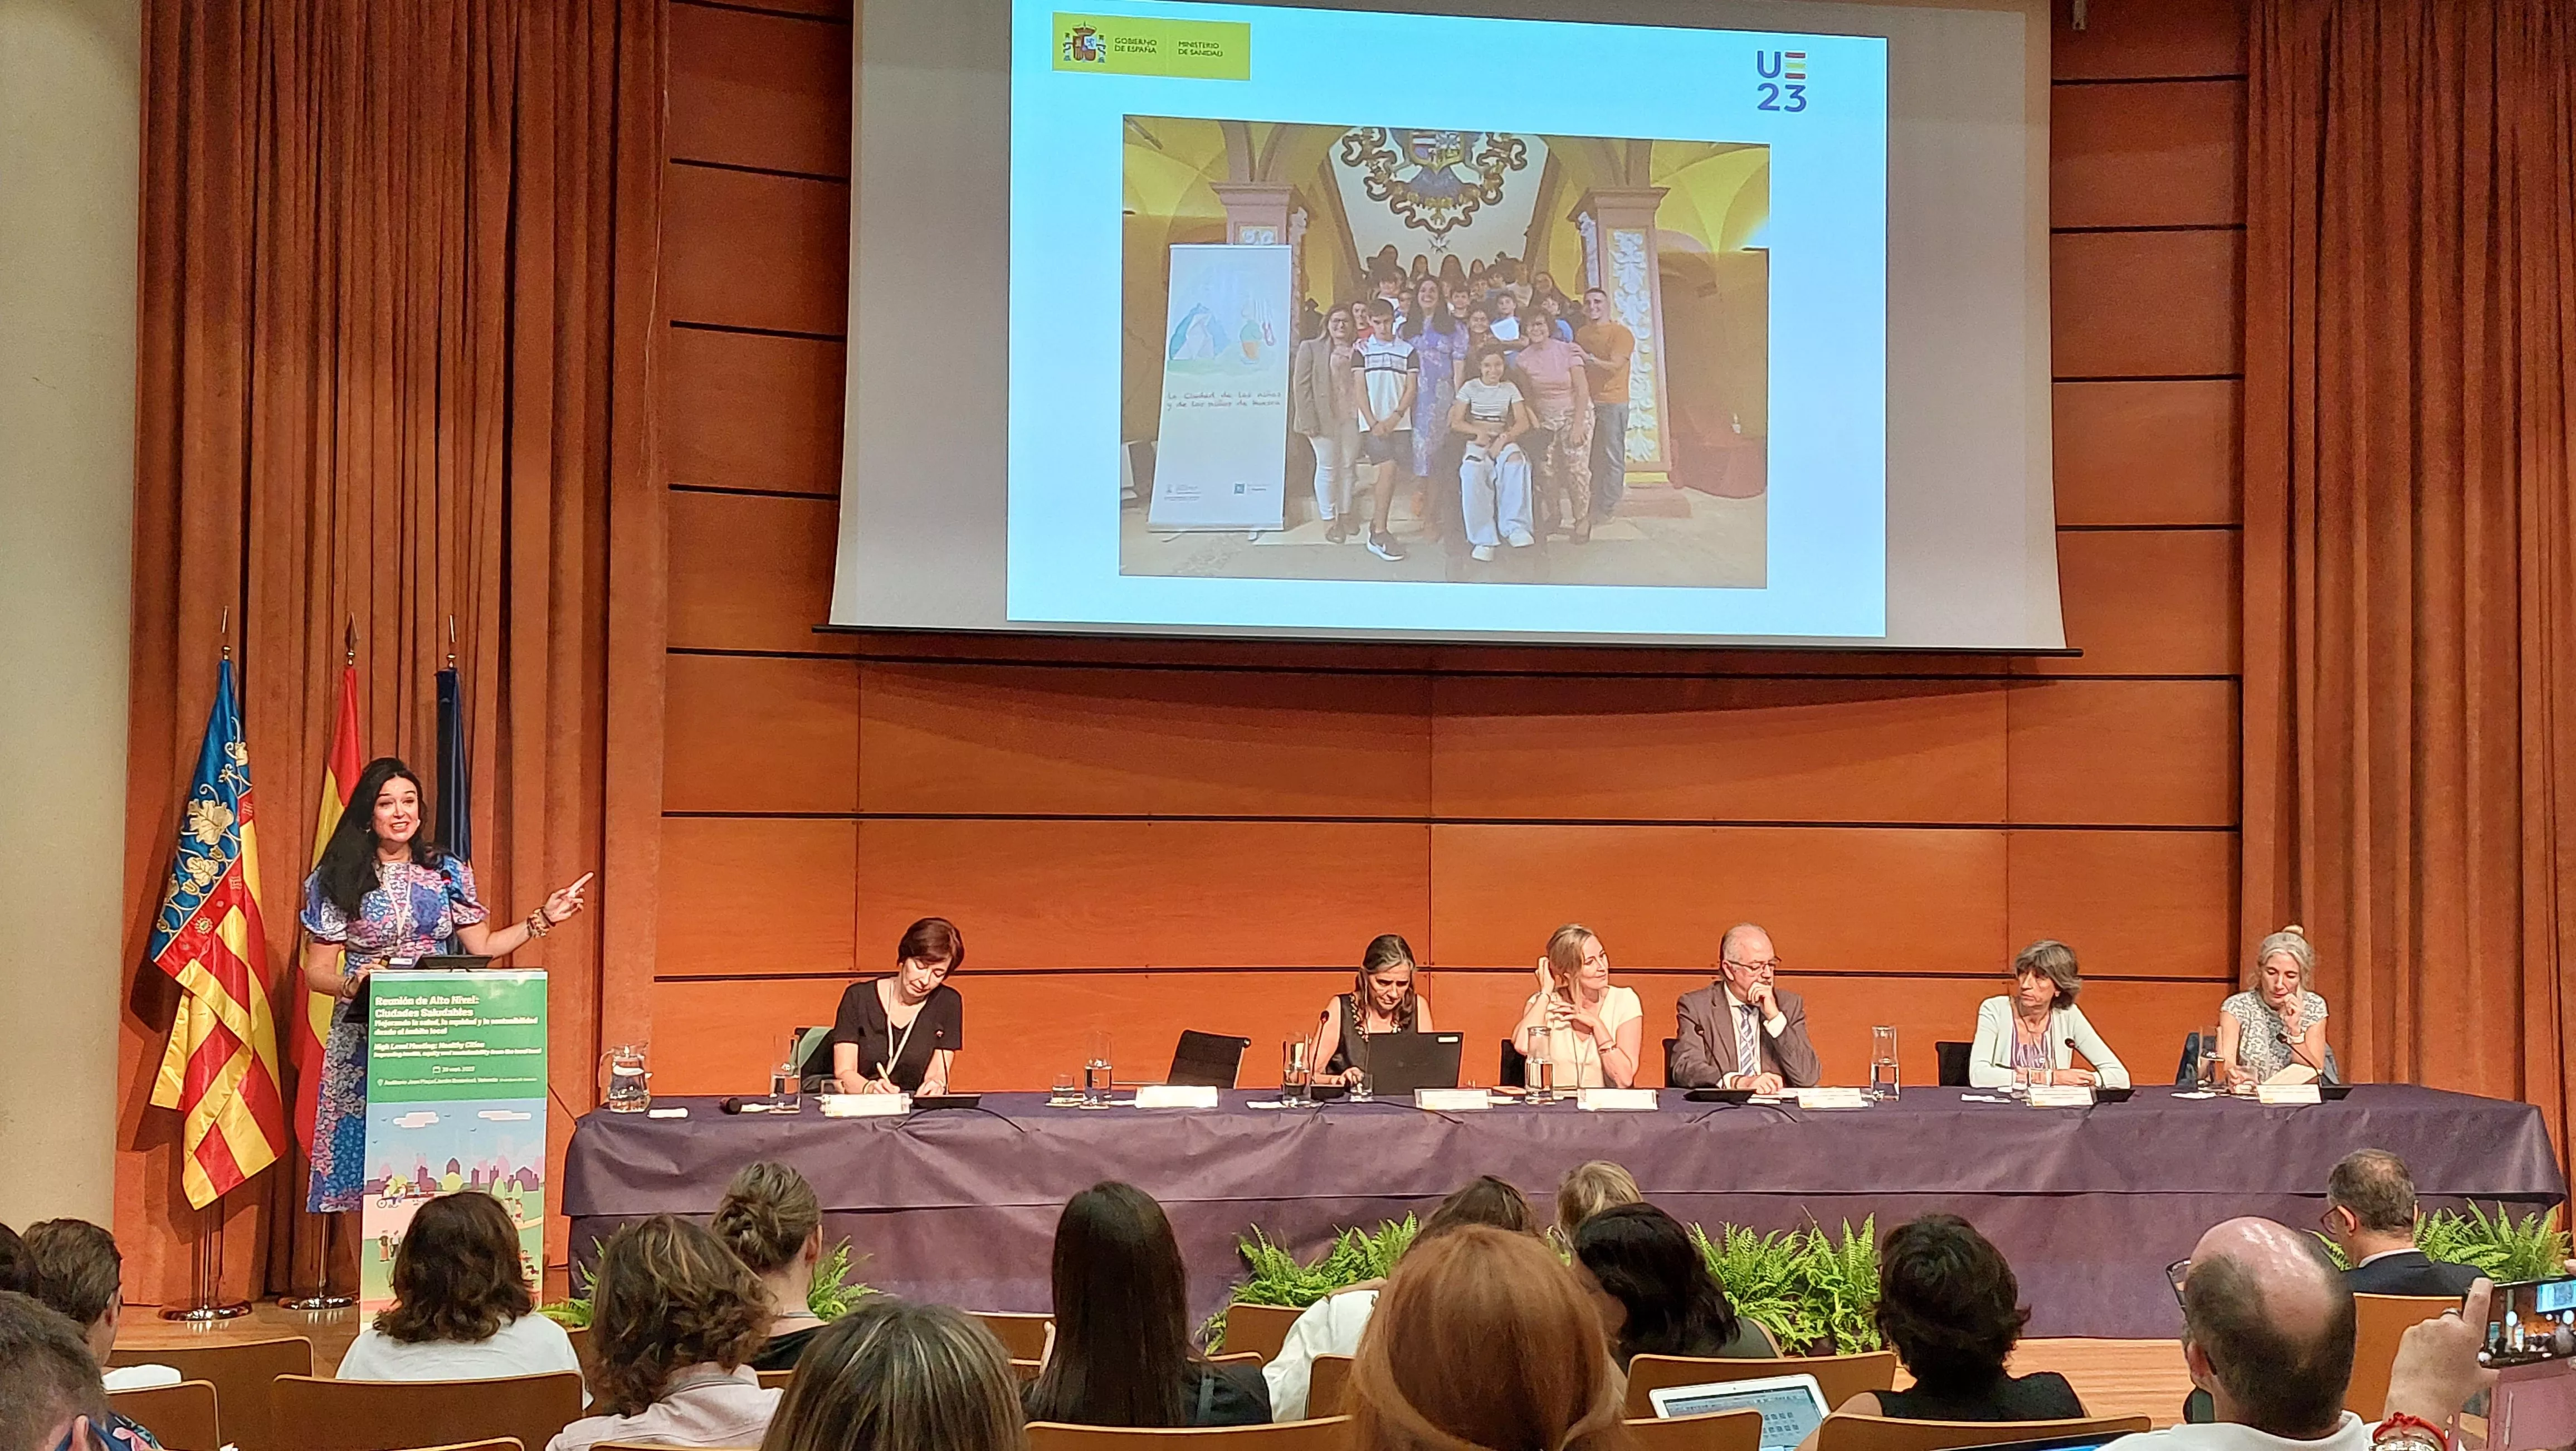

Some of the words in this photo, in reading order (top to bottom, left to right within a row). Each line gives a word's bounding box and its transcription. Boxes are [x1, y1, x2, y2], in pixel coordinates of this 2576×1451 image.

[1115, 37, 1157, 46] GOBIERNO
[1128, 45, 1157, 53] ESPAÑA
[1757, 82, 1807, 112] 23
[375, 996, 414, 1006] Reunión
[415, 996, 428, 1005] de
[429, 996, 450, 1005] Alto
[451, 995, 480, 1005] Nivel:
[375, 1009, 419, 1018] Ciudades
[420, 1007, 474, 1017] Saludables
